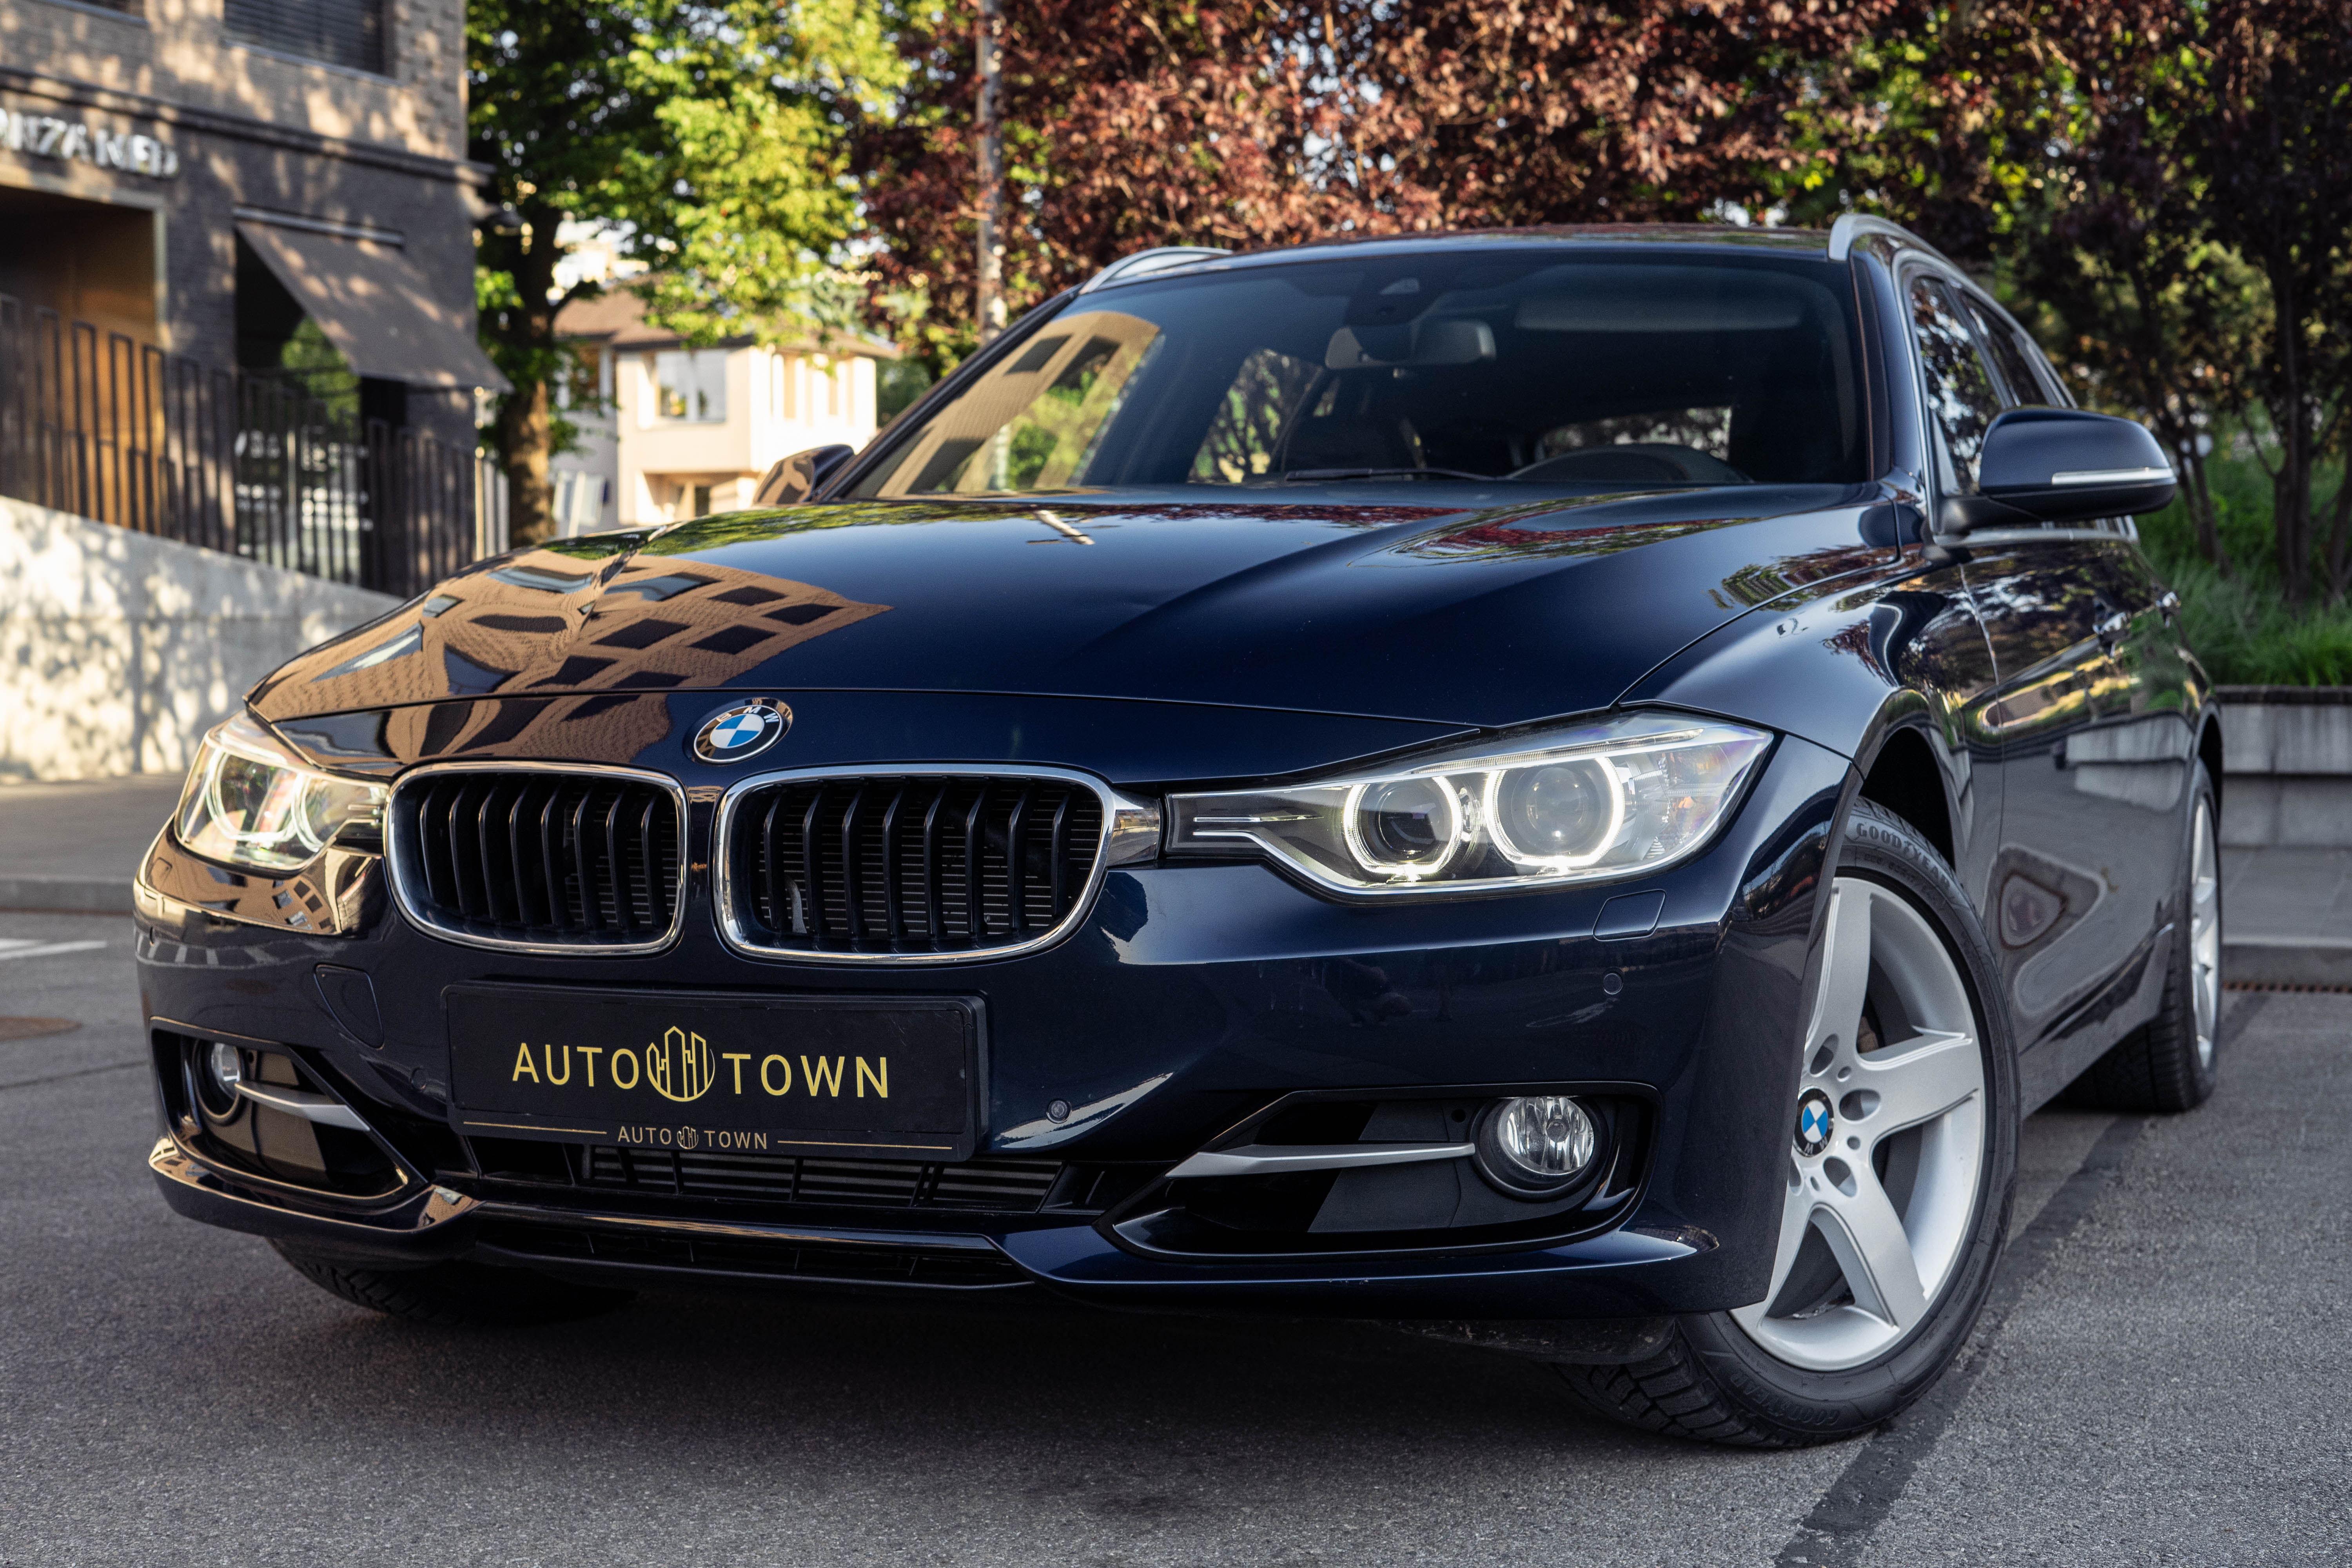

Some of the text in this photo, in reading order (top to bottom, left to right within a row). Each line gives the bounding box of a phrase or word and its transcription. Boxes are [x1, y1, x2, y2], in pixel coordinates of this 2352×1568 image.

[716, 706, 779, 723] BMW
[1856, 822, 1951, 889] GOODYEAR
[512, 1043, 887, 1098] AUTO TOWN
[618, 1125, 767, 1149] AUTO TOWN
[1804, 1117, 1834, 1154] BMW
[1730, 1373, 1840, 1426] GOODYEAR
